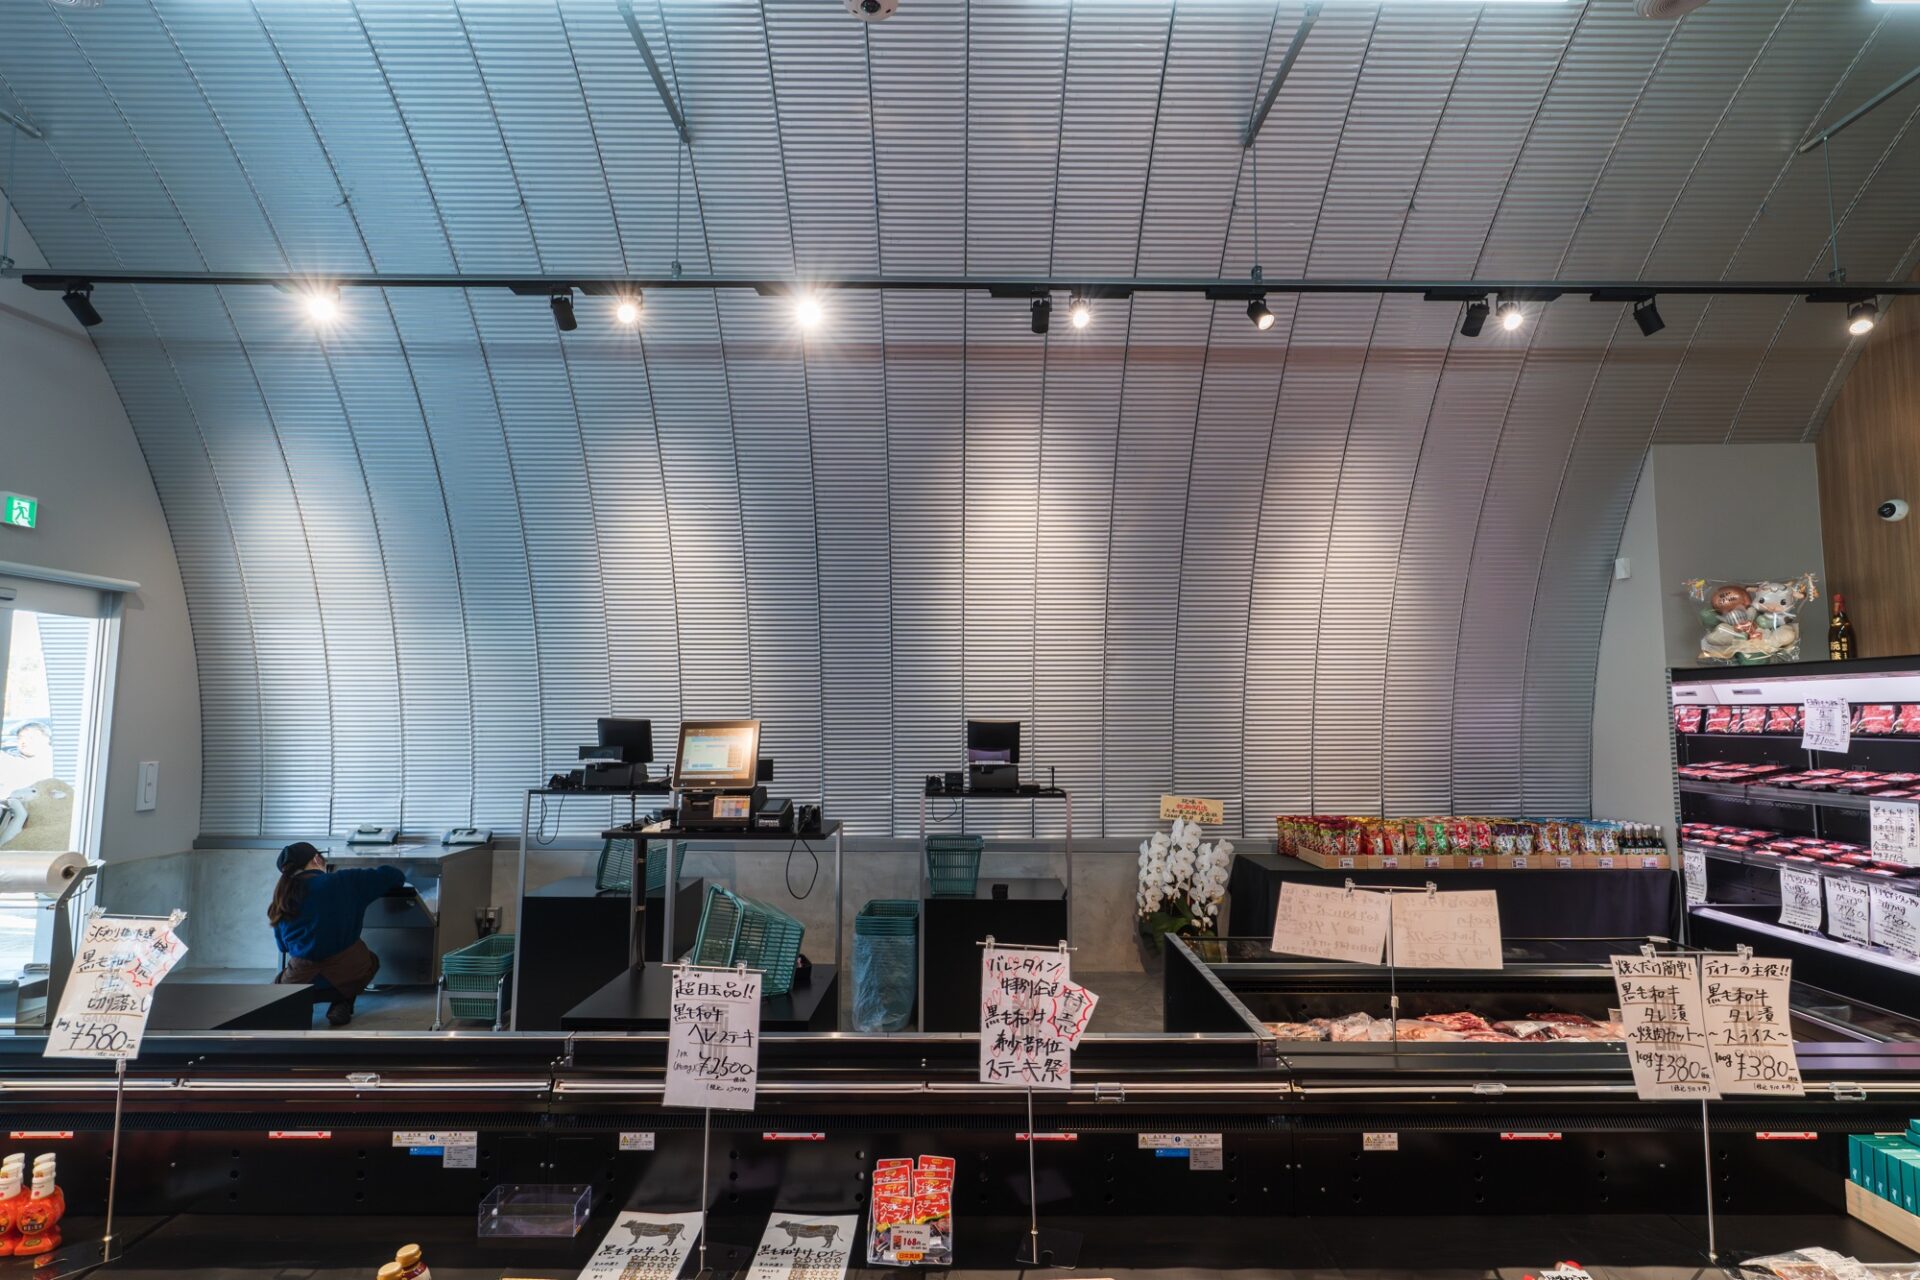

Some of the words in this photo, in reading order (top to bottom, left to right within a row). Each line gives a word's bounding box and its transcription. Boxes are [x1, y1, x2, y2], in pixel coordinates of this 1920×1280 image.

[989, 955, 1062, 975] バレンタイン
[1621, 982, 1681, 1004] 黒毛和牛
[1707, 983, 1769, 1005] 黒毛和牛
[87, 994, 149, 1014] 切り落とし
[673, 1003, 724, 1022] 黒毛和牛
[984, 1004, 1046, 1028] 黒毛和牛
[1644, 1006, 1688, 1023] タレ漬
[1729, 1008, 1775, 1023] タレ漬
[994, 1029, 1066, 1057] 希少部位
[986, 1058, 1063, 1082] ステーキ祭
[880, 1202, 911, 1213] ステーキ
[916, 1207, 941, 1216] ソース
[917, 1198, 948, 1209] ステーキ
[879, 1211, 905, 1223] ソース
[598, 1244, 656, 1257] 黒毛和牛
